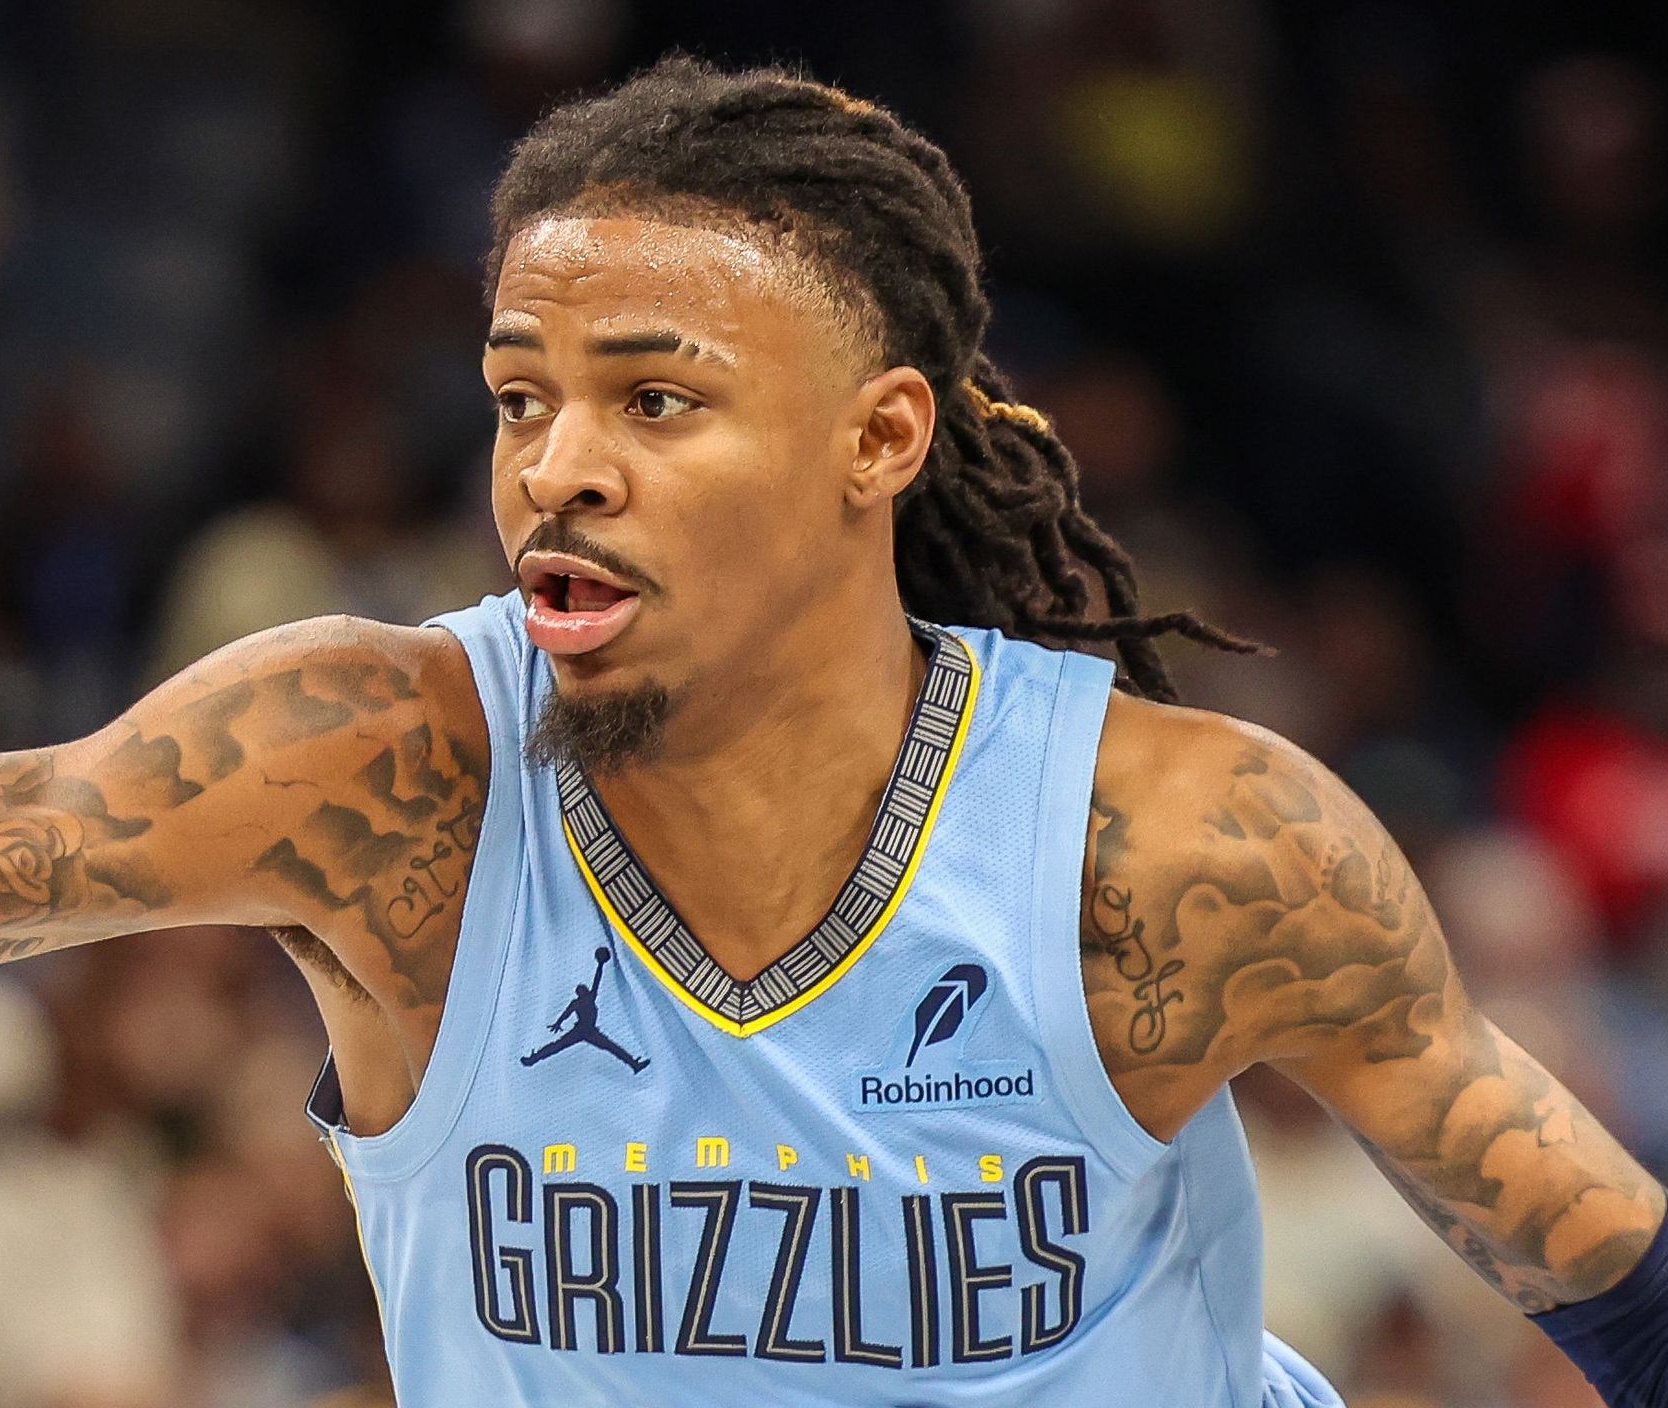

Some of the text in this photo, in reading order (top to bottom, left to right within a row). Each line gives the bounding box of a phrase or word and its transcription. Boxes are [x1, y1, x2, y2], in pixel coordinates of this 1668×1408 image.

[861, 1070, 1035, 1106] Robinhood
[543, 1136, 1005, 1184] MEMPHIS
[465, 1143, 1090, 1370] GRIZZLIES
